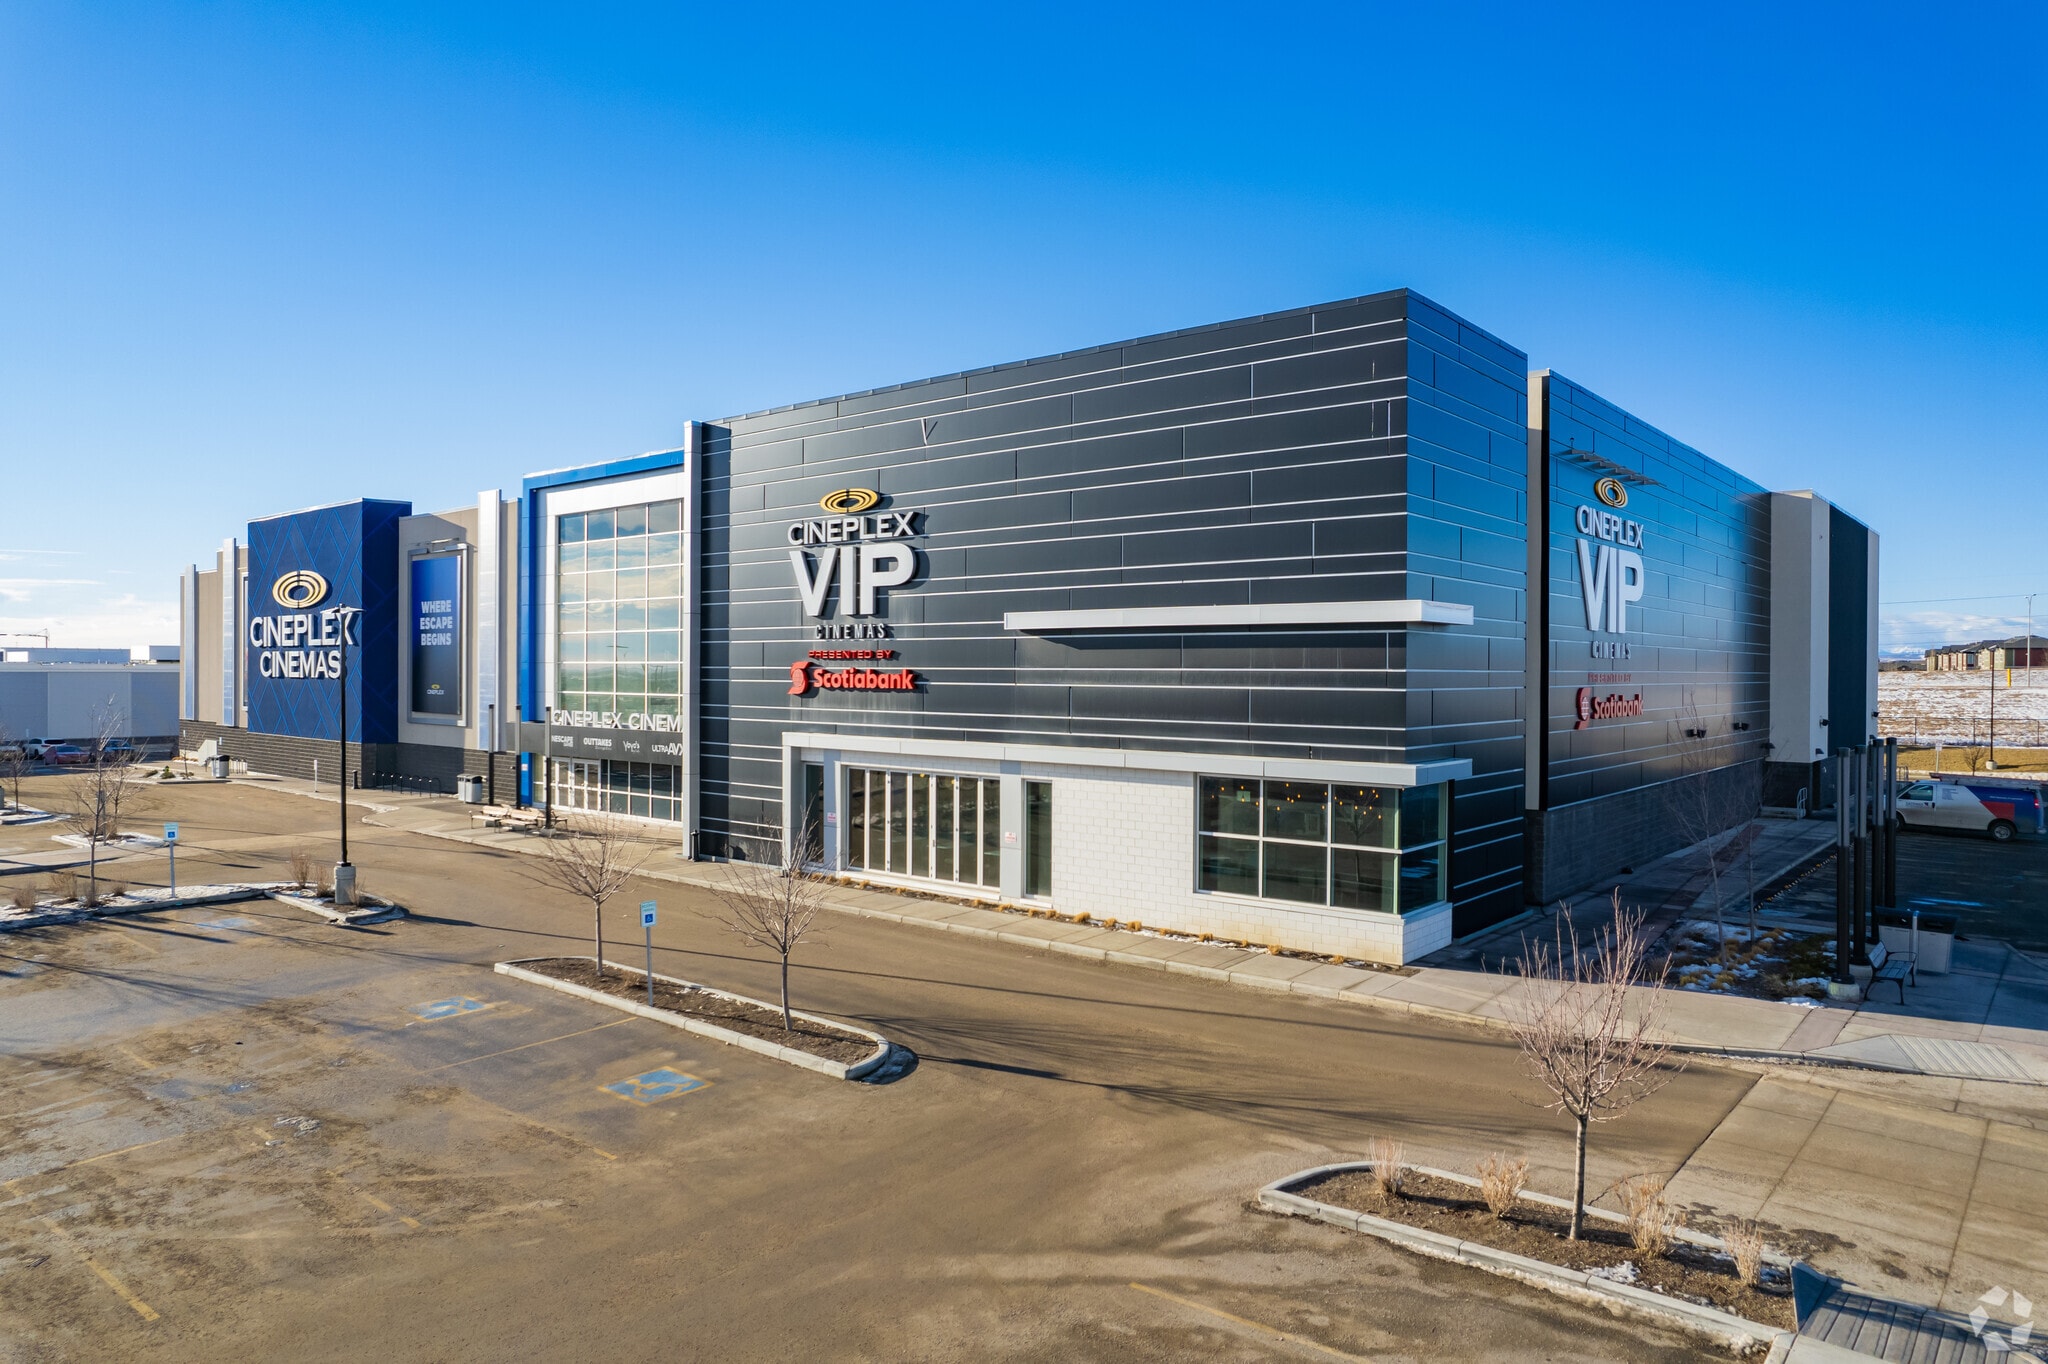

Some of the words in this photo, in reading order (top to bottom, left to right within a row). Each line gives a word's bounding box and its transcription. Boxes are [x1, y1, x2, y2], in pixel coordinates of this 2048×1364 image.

[787, 511, 915, 545] CINEPLEX
[1577, 505, 1644, 549] CINEPLEX
[789, 542, 915, 617] VIP
[1577, 538, 1645, 633] VIP
[421, 600, 452, 614] WHERE
[250, 612, 353, 647] CINEPLEX
[420, 616, 453, 630] ESCAPE
[814, 623, 885, 639] CINEMAS
[421, 633, 452, 646] BEGINS
[1592, 640, 1631, 659] CINEMAS
[260, 650, 341, 679] CINEMAS
[808, 650, 872, 659] PRESENTED
[876, 650, 892, 659] BY
[813, 667, 915, 690] Scotiabank
[1593, 693, 1644, 719] Scotiabank
[552, 709, 623, 730] CINEPLEX
[628, 713, 683, 732] CINEM
[583, 737, 612, 747] OUTTAKES
